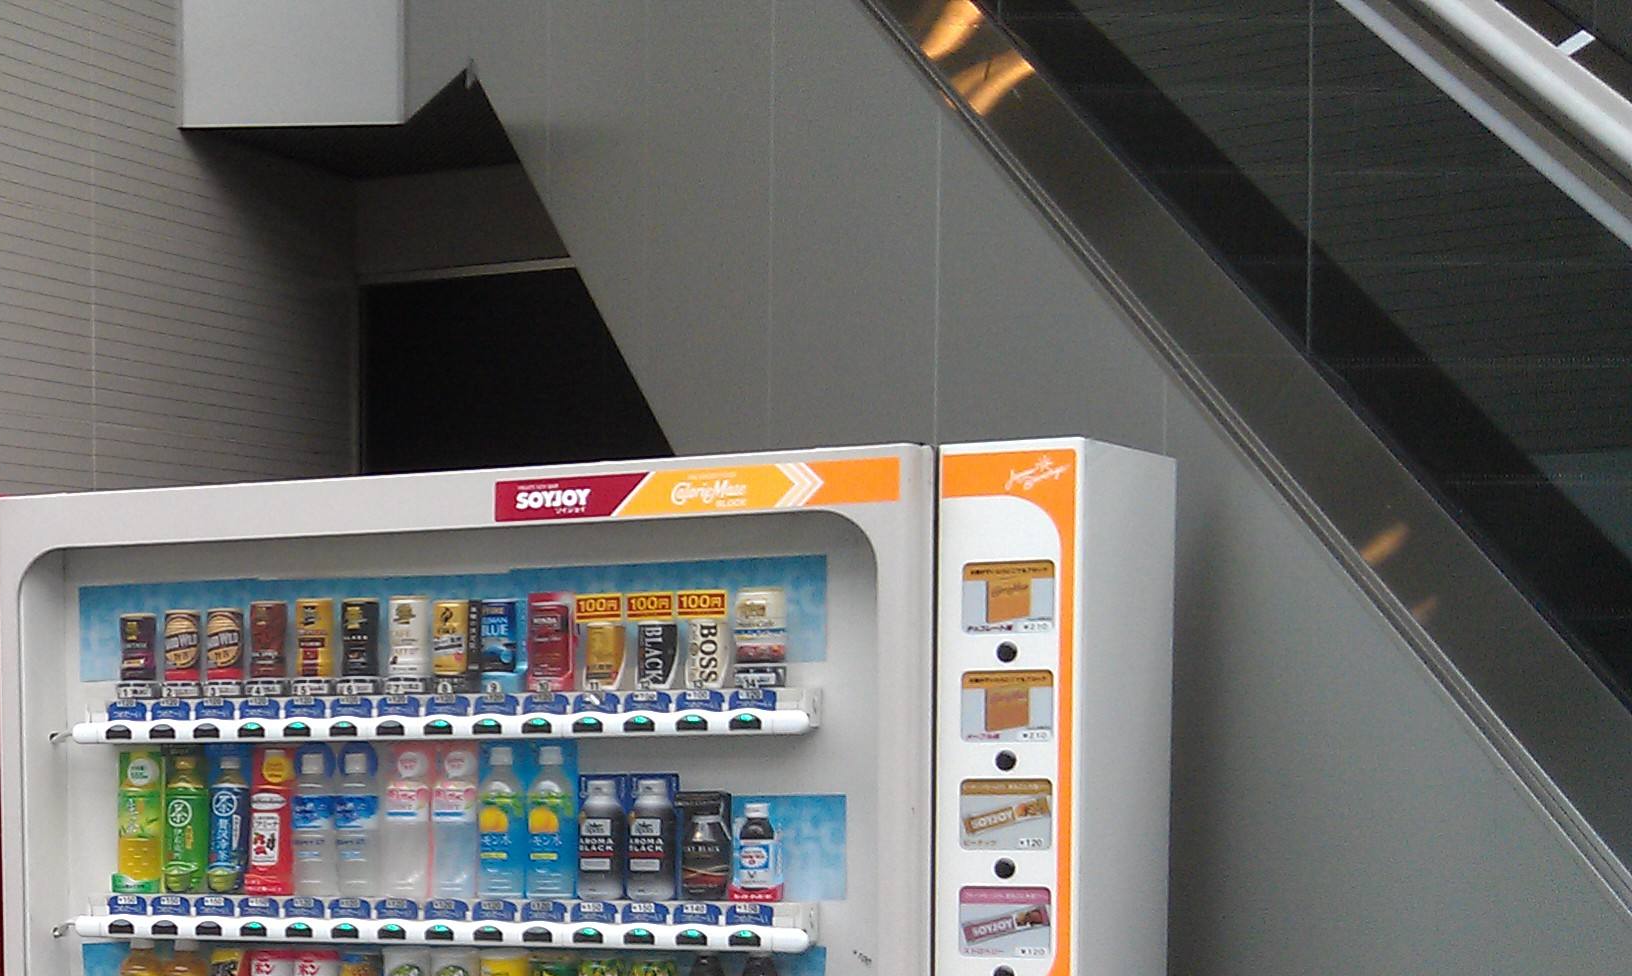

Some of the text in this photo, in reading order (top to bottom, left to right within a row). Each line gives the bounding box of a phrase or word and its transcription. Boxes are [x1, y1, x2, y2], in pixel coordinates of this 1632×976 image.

[516, 488, 591, 509] SOYJOY
[578, 598, 618, 612] 100円
[630, 597, 669, 610] 100円
[679, 595, 722, 609] 100円
[1023, 622, 1049, 632] ¥210
[644, 626, 663, 685] BLACK
[700, 624, 718, 683] BOSS
[1023, 731, 1048, 740] ¥210
[971, 811, 1014, 829] SOYJOY
[1020, 838, 1043, 847] ¥120
[972, 918, 1014, 936] SOYJOY
[1021, 948, 1045, 956] ¥120
